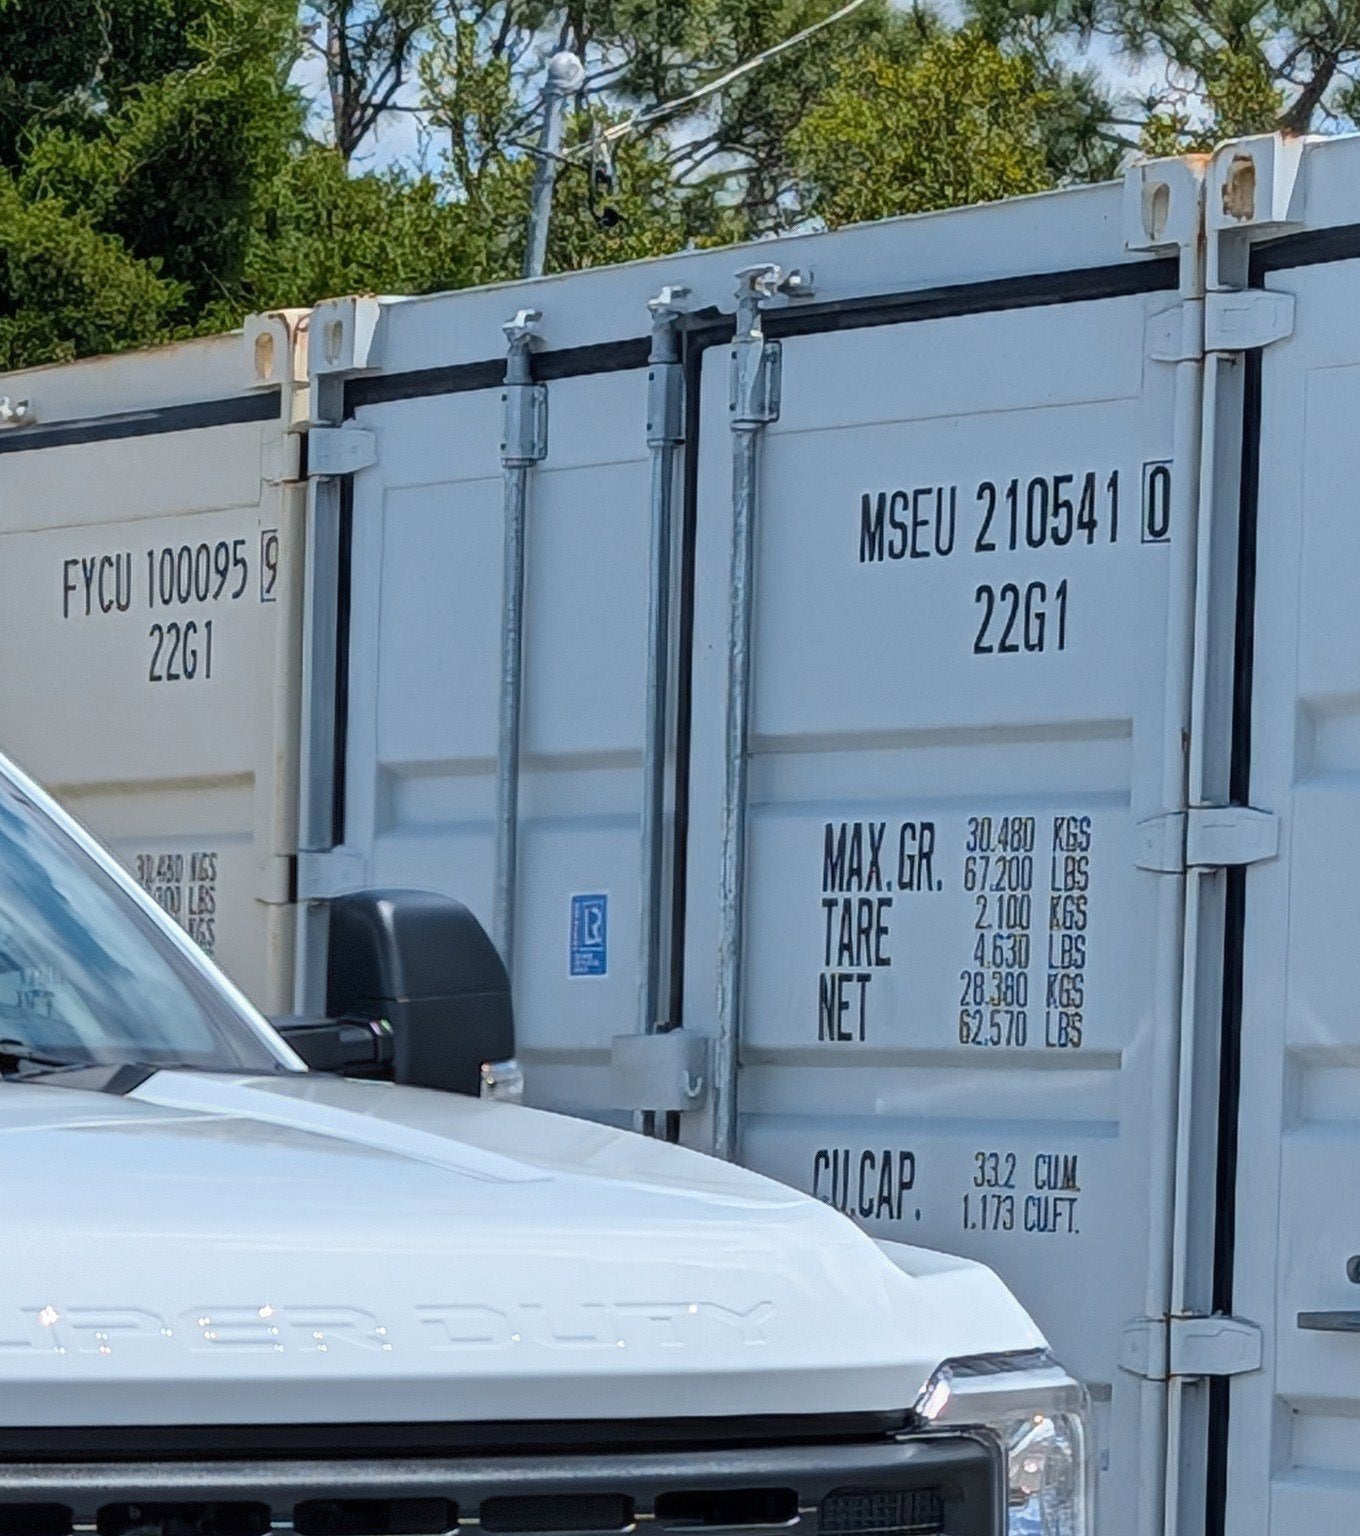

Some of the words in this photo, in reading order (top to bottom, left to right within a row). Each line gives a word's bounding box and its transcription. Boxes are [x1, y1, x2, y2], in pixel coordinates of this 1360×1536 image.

[859, 486, 957, 562] MSEU
[974, 471, 1119, 552] 210541
[1147, 465, 1171, 538] 0
[64, 553, 131, 618] FYCU
[147, 540, 248, 608] 100095
[264, 535, 279, 594] 9
[974, 580, 1070, 654] 22G1
[149, 620, 212, 682] 22G1
[1053, 816, 1092, 852] KGS
[1051, 855, 1089, 892] LBS
[822, 897, 893, 967] TARE
[1049, 894, 1088, 931] KGS
[1048, 933, 1086, 970] LBS
[818, 972, 872, 1042] NET
[1046, 972, 1084, 1009] KGS
[1045, 1010, 1083, 1048] LBS
[414, 1301, 778, 1352] DUTY
